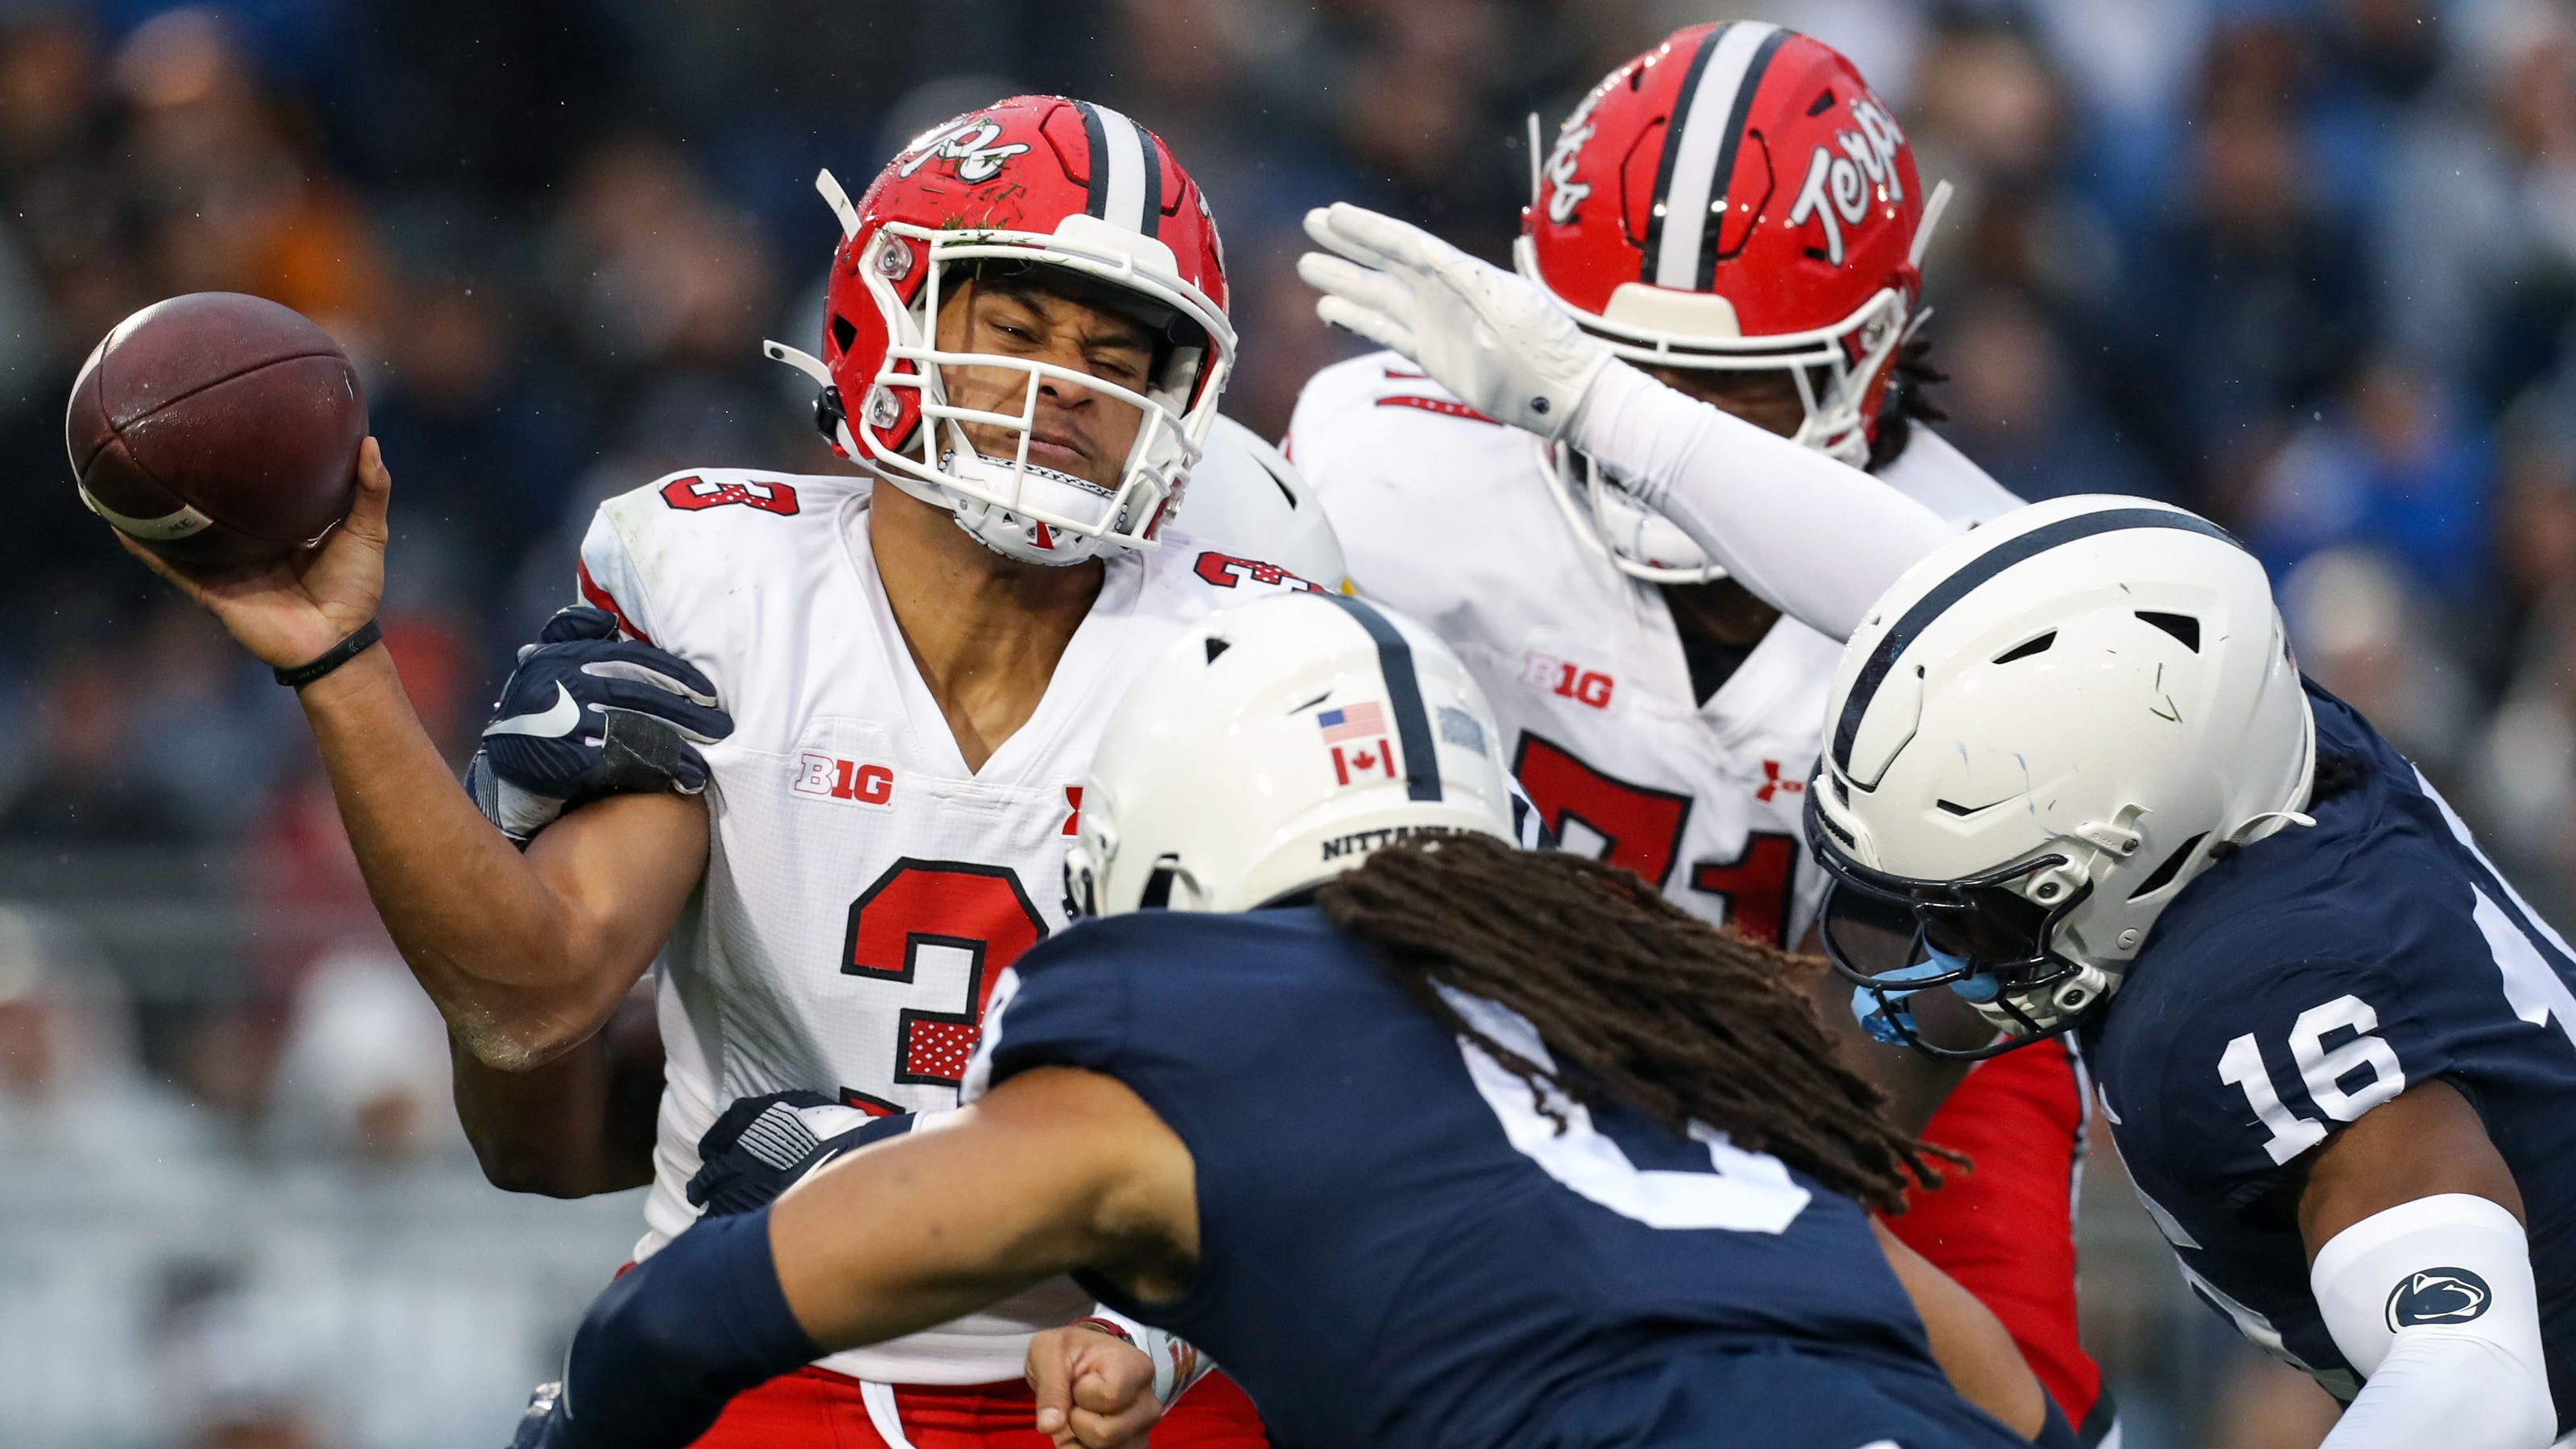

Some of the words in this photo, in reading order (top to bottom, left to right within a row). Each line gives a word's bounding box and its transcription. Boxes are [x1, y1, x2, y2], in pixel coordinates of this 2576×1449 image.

[1789, 93, 1906, 267] Terp
[660, 476, 799, 517] 3
[1513, 728, 1800, 952] 71
[840, 856, 1050, 1117] 3
[2217, 993, 2406, 1166] 16
